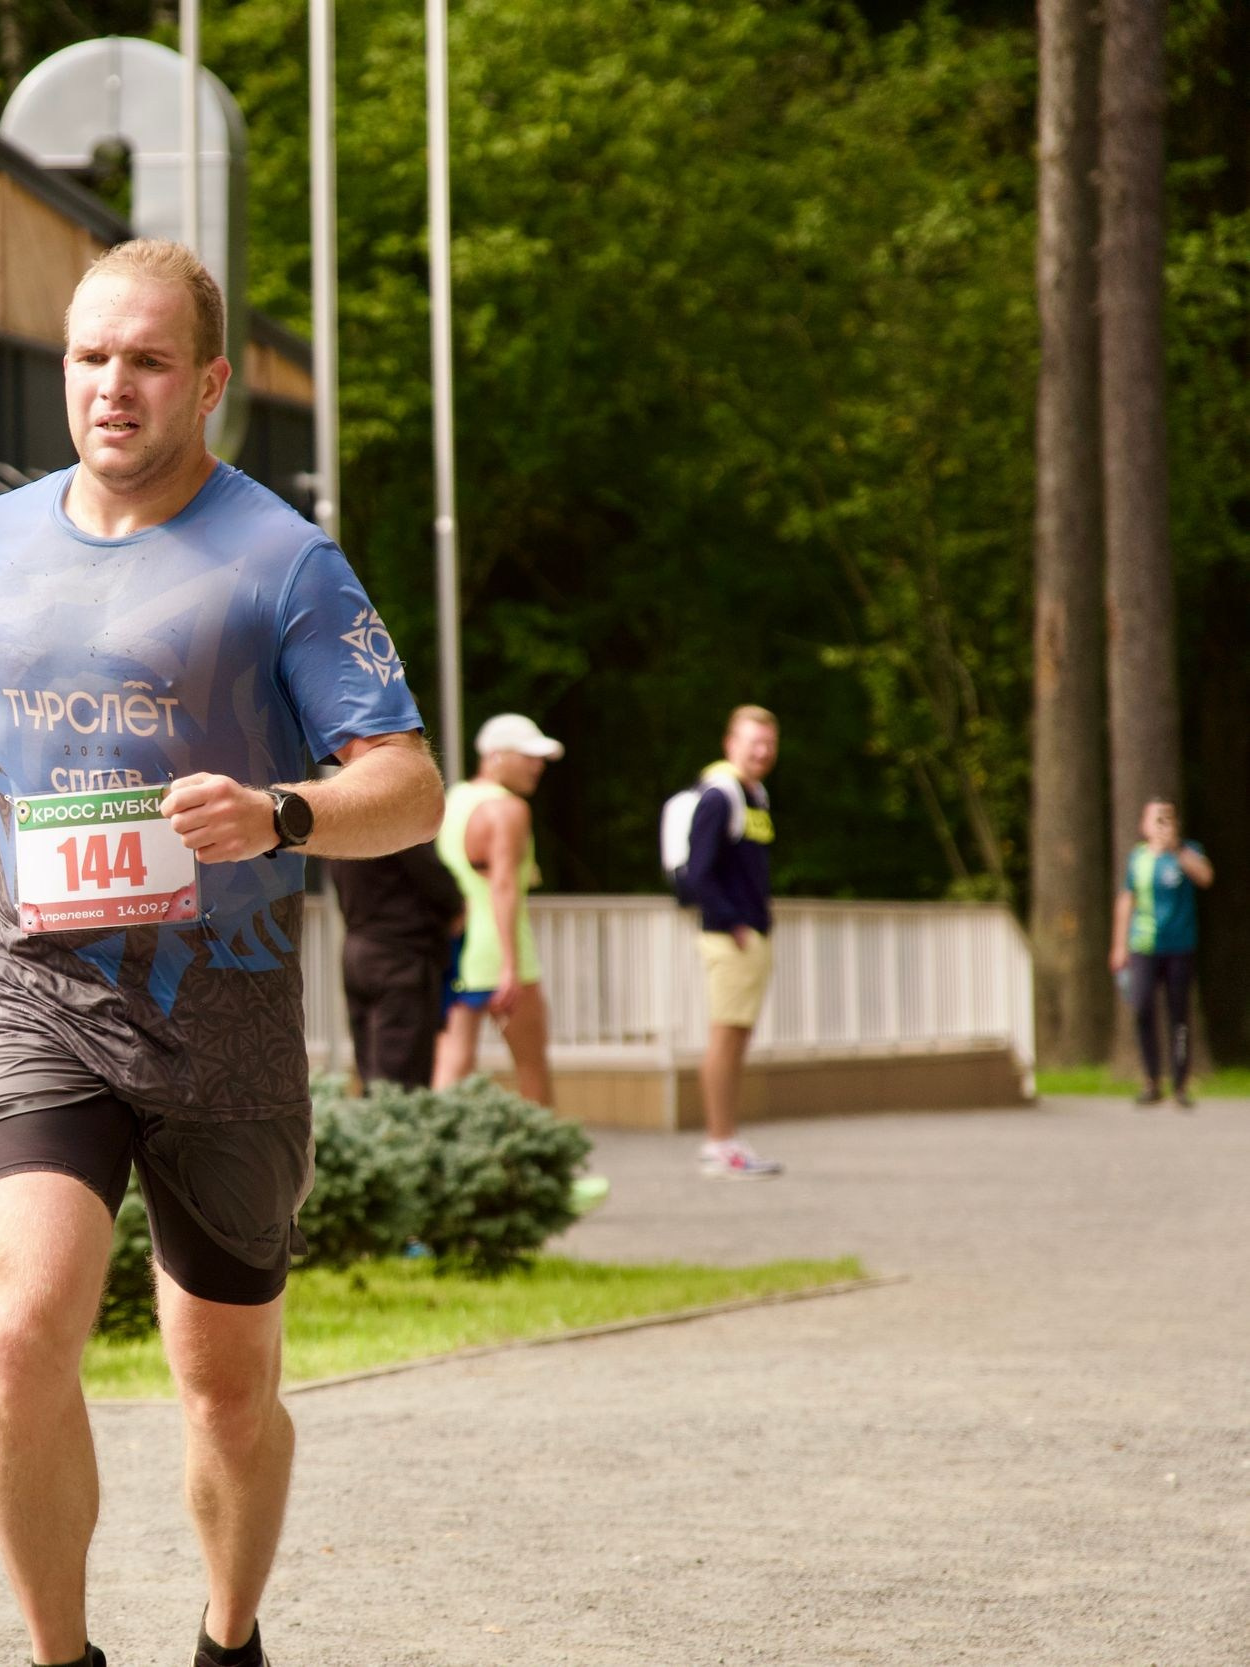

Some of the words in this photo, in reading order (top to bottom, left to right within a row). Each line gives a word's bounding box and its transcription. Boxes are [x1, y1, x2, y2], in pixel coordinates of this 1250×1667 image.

[63, 744, 121, 758] 2024
[50, 767, 145, 793] СПЛАВ
[32, 803, 96, 823] КРОСС
[57, 831, 148, 892] 144
